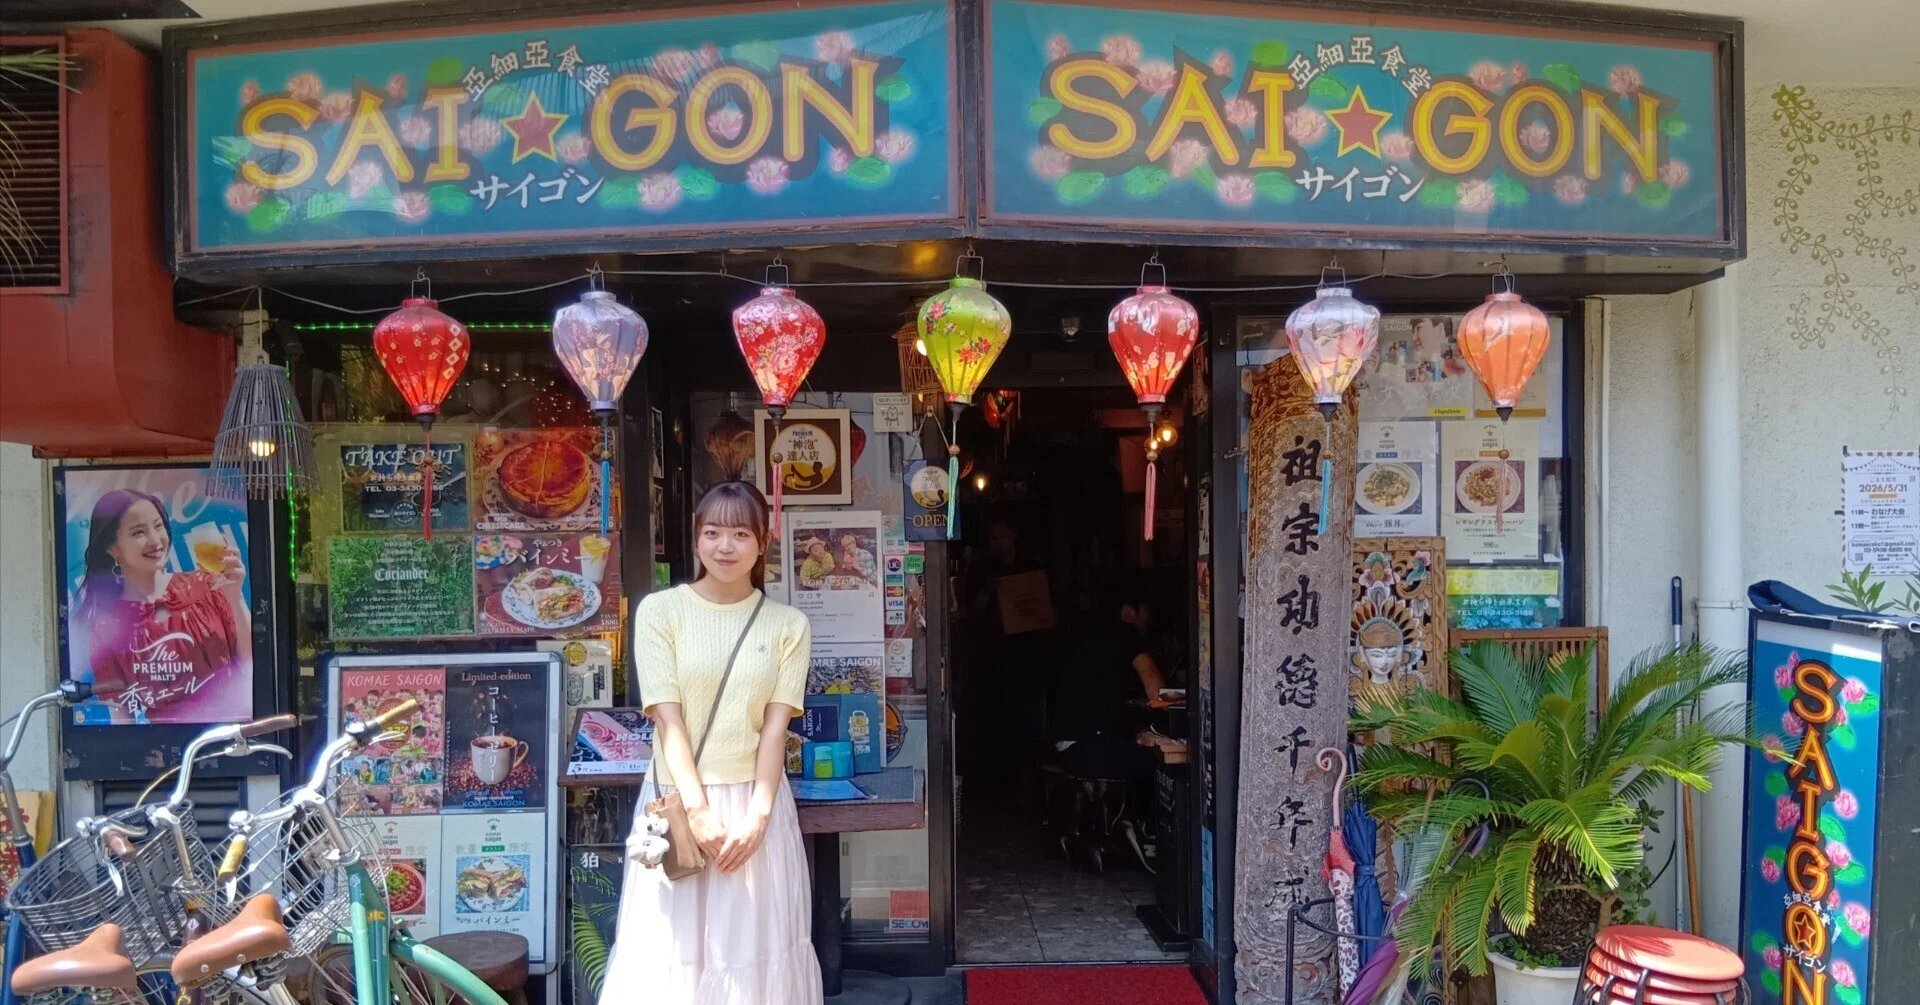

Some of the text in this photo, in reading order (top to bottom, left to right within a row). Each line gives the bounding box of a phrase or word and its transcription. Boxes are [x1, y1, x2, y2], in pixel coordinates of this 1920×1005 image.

[463, 39, 612, 102] 亞細亞食堂
[1288, 35, 1432, 96] 亞細亞食堂
[1295, 167, 1424, 202] サイゴン
[469, 175, 606, 211] サイゴン
[1859, 484, 1908, 493] 2026/5/31
[912, 514, 949, 527] OPEN
[533, 538, 563, 548] やみつき
[505, 547, 593, 566] バインミー
[374, 567, 430, 582] Coriander
[133, 662, 193, 674] PREMIUM
[840, 657, 881, 667] SAIGON
[150, 674, 177, 682] MALT'S
[347, 673, 443, 687] KOMAE SAIGON
[461, 671, 531, 682] Limited-edition
[119, 672, 216, 714] 香るエール
[806, 708, 814, 737] SAIGON
[489, 686, 500, 782] コーヒーゼリー
[474, 915, 521, 925] バインミー
[892, 920, 929, 928] SECOM
[1783, 944, 1826, 974] サイゴン
